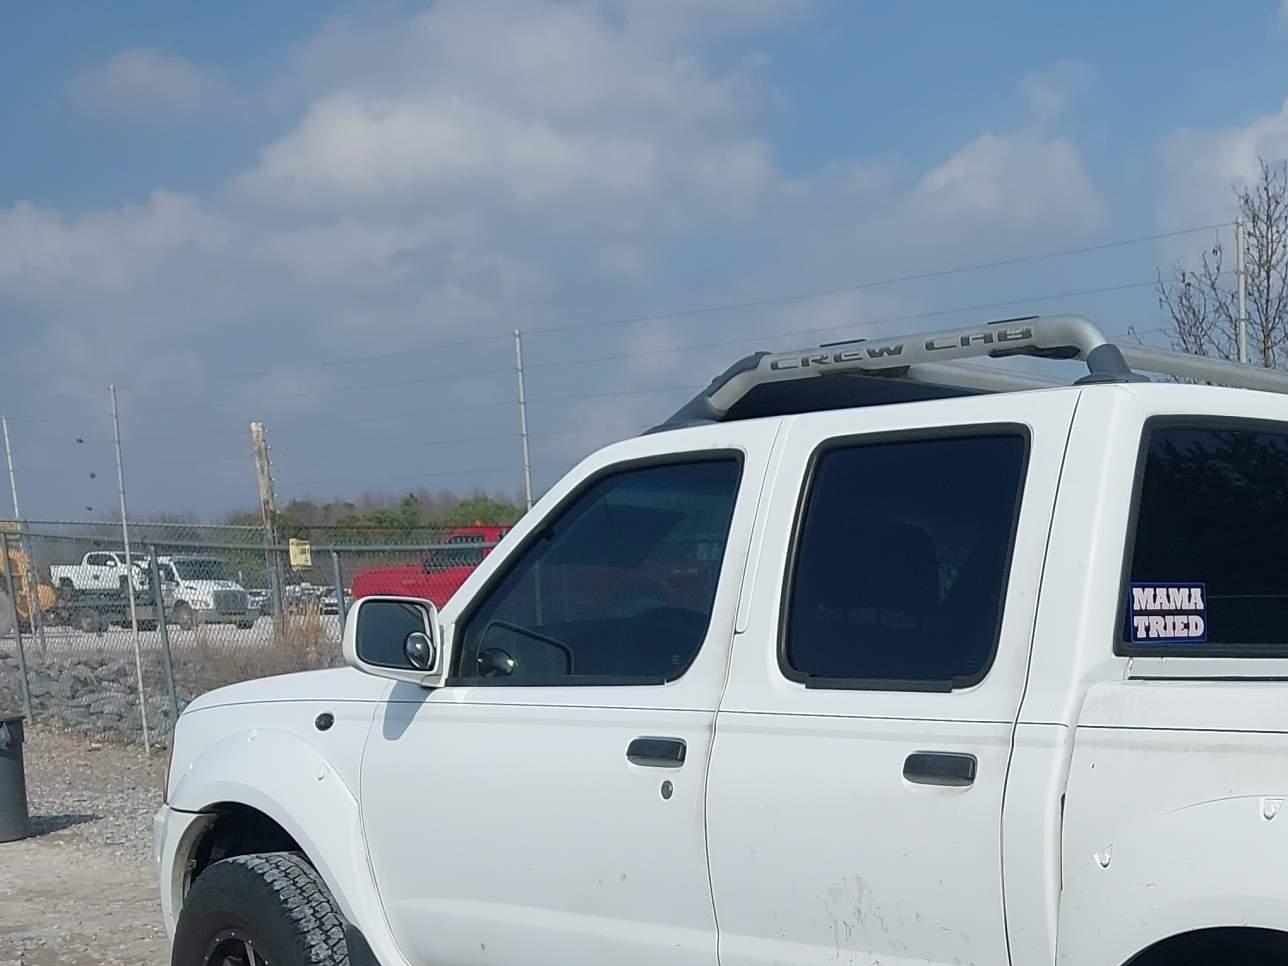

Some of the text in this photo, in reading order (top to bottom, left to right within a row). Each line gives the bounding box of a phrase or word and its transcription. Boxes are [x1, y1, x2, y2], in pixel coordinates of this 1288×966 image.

[770, 327, 1033, 371] CREW CAB
[1132, 587, 1204, 610] MAMA
[1133, 614, 1205, 638] TRIED
